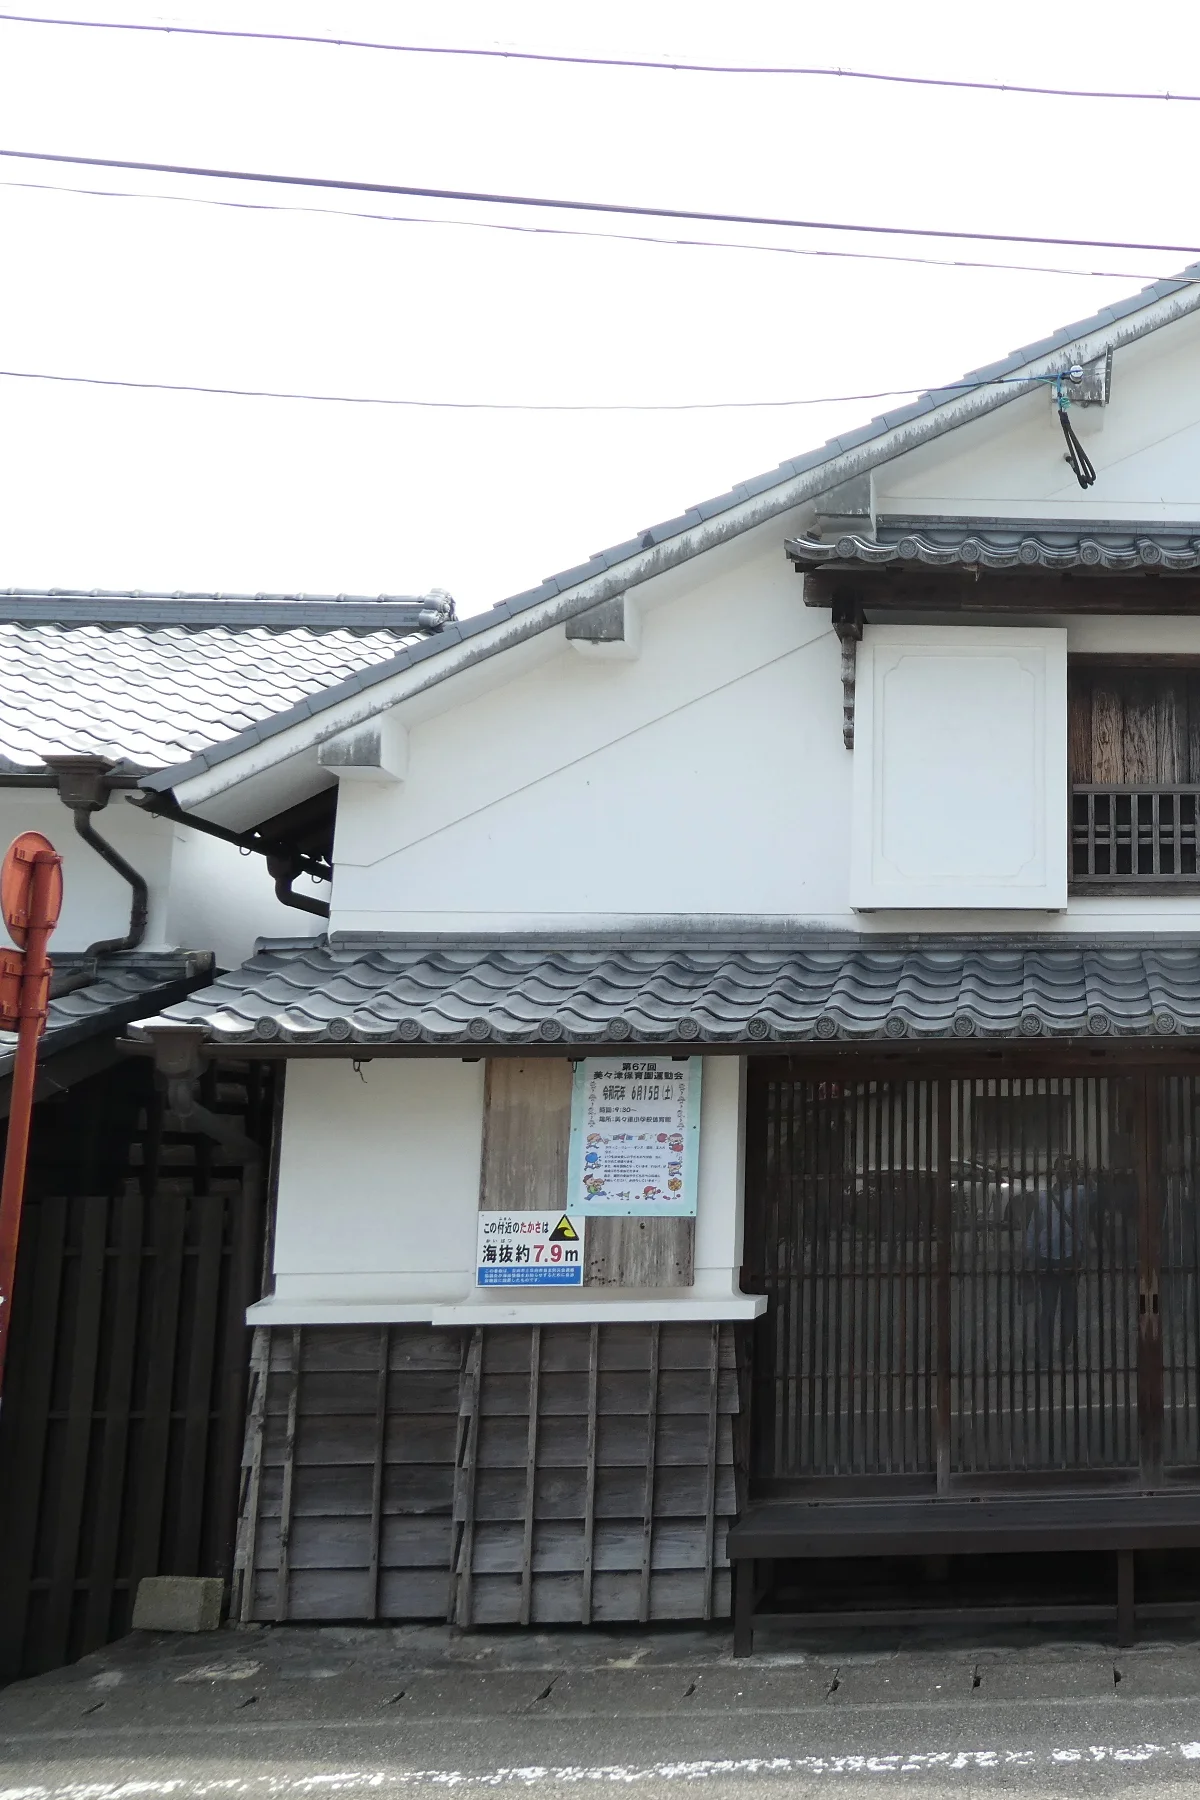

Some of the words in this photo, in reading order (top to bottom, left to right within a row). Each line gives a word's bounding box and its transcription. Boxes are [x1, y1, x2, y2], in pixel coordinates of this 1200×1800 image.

[622, 1063, 656, 1071] 第67回
[594, 1071, 683, 1080] 美々津保育園運動会
[603, 1085, 626, 1100] 令和元年
[484, 1222, 549, 1234] この付近のたかさは
